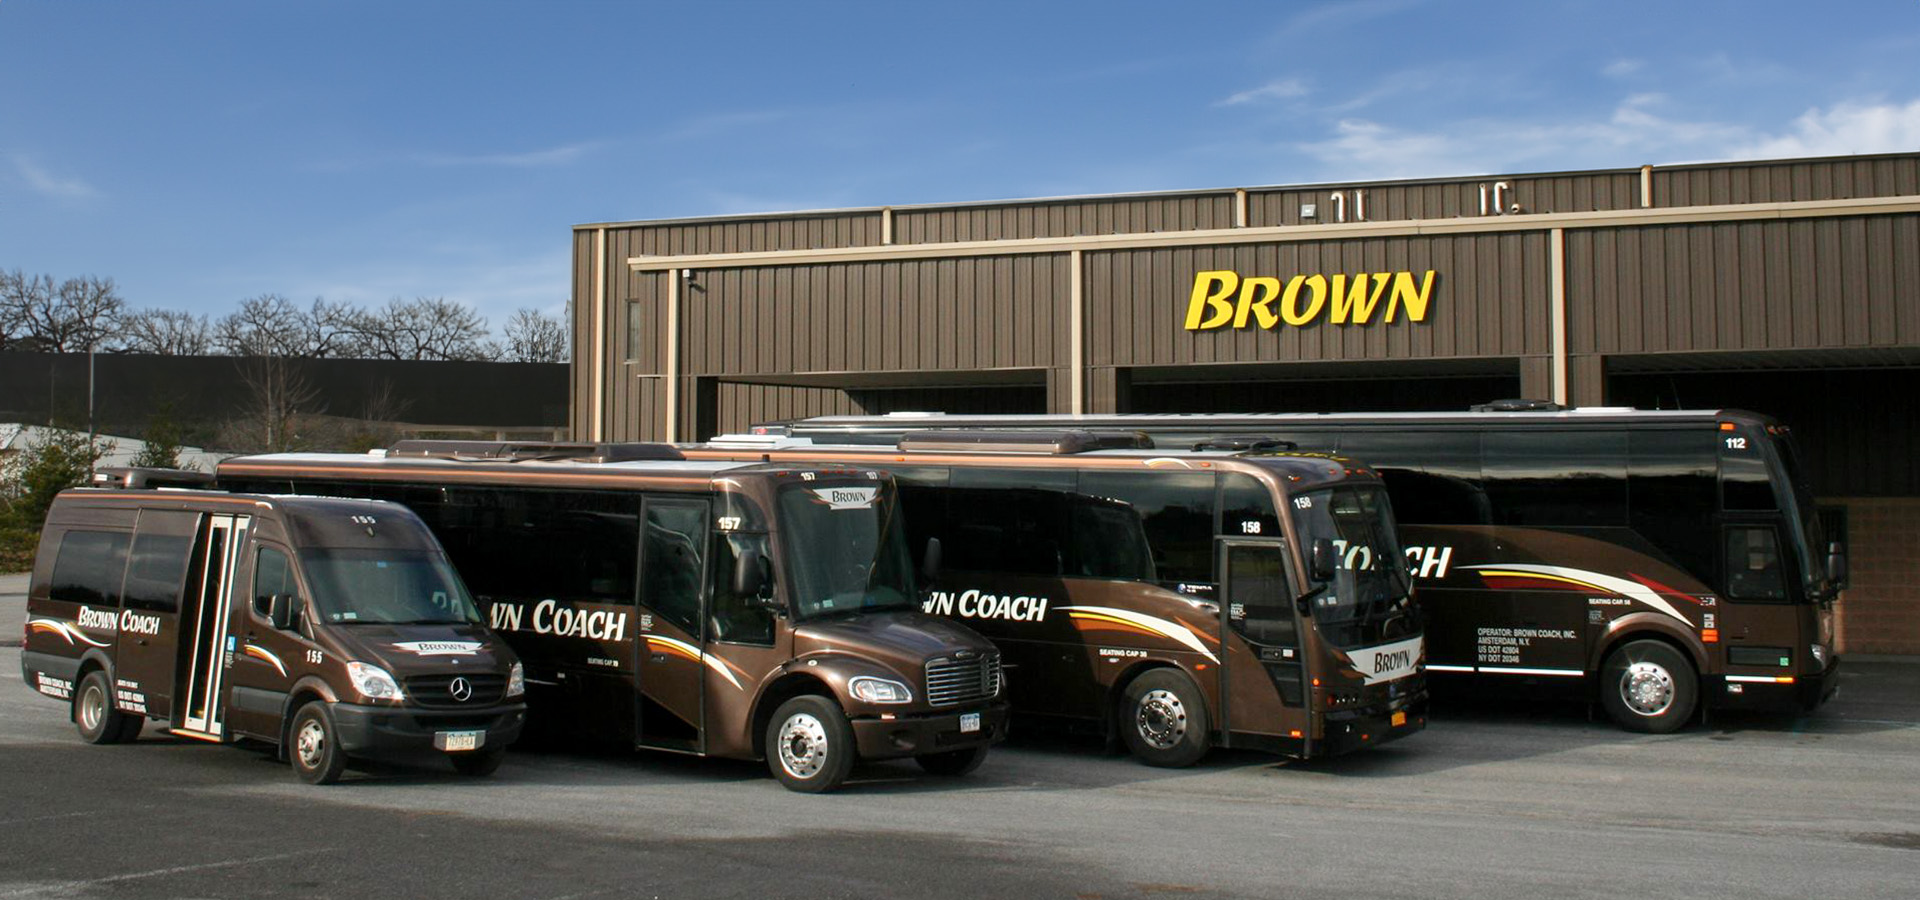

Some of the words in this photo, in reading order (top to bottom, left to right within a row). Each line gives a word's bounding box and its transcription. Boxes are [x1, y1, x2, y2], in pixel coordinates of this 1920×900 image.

[1184, 269, 1436, 330] BROWN
[1726, 437, 1746, 449] 112
[800, 472, 816, 481] 157
[832, 490, 866, 503] BROWN
[1293, 497, 1312, 509] 158
[351, 515, 376, 524] 155
[718, 517, 741, 530] 157
[1241, 521, 1261, 533] 158
[958, 589, 1048, 622] COACH
[78, 605, 119, 630] BROWN
[121, 609, 160, 635] COACH
[532, 599, 627, 642] COACH
[1513, 629, 1538, 638] BROWN
[1537, 630, 1563, 639] COACH,
[1563, 631, 1577, 639] INC.
[418, 643, 467, 651] BROWN
[1477, 636, 1518, 646] AMSTERDAM,
[1478, 645, 1487, 653] US
[1487, 646, 1501, 654] DOT
[306, 650, 323, 664] 155
[1374, 650, 1410, 674] BROWN
[1478, 654, 1487, 662] NY
[1487, 655, 1501, 663] DOT
